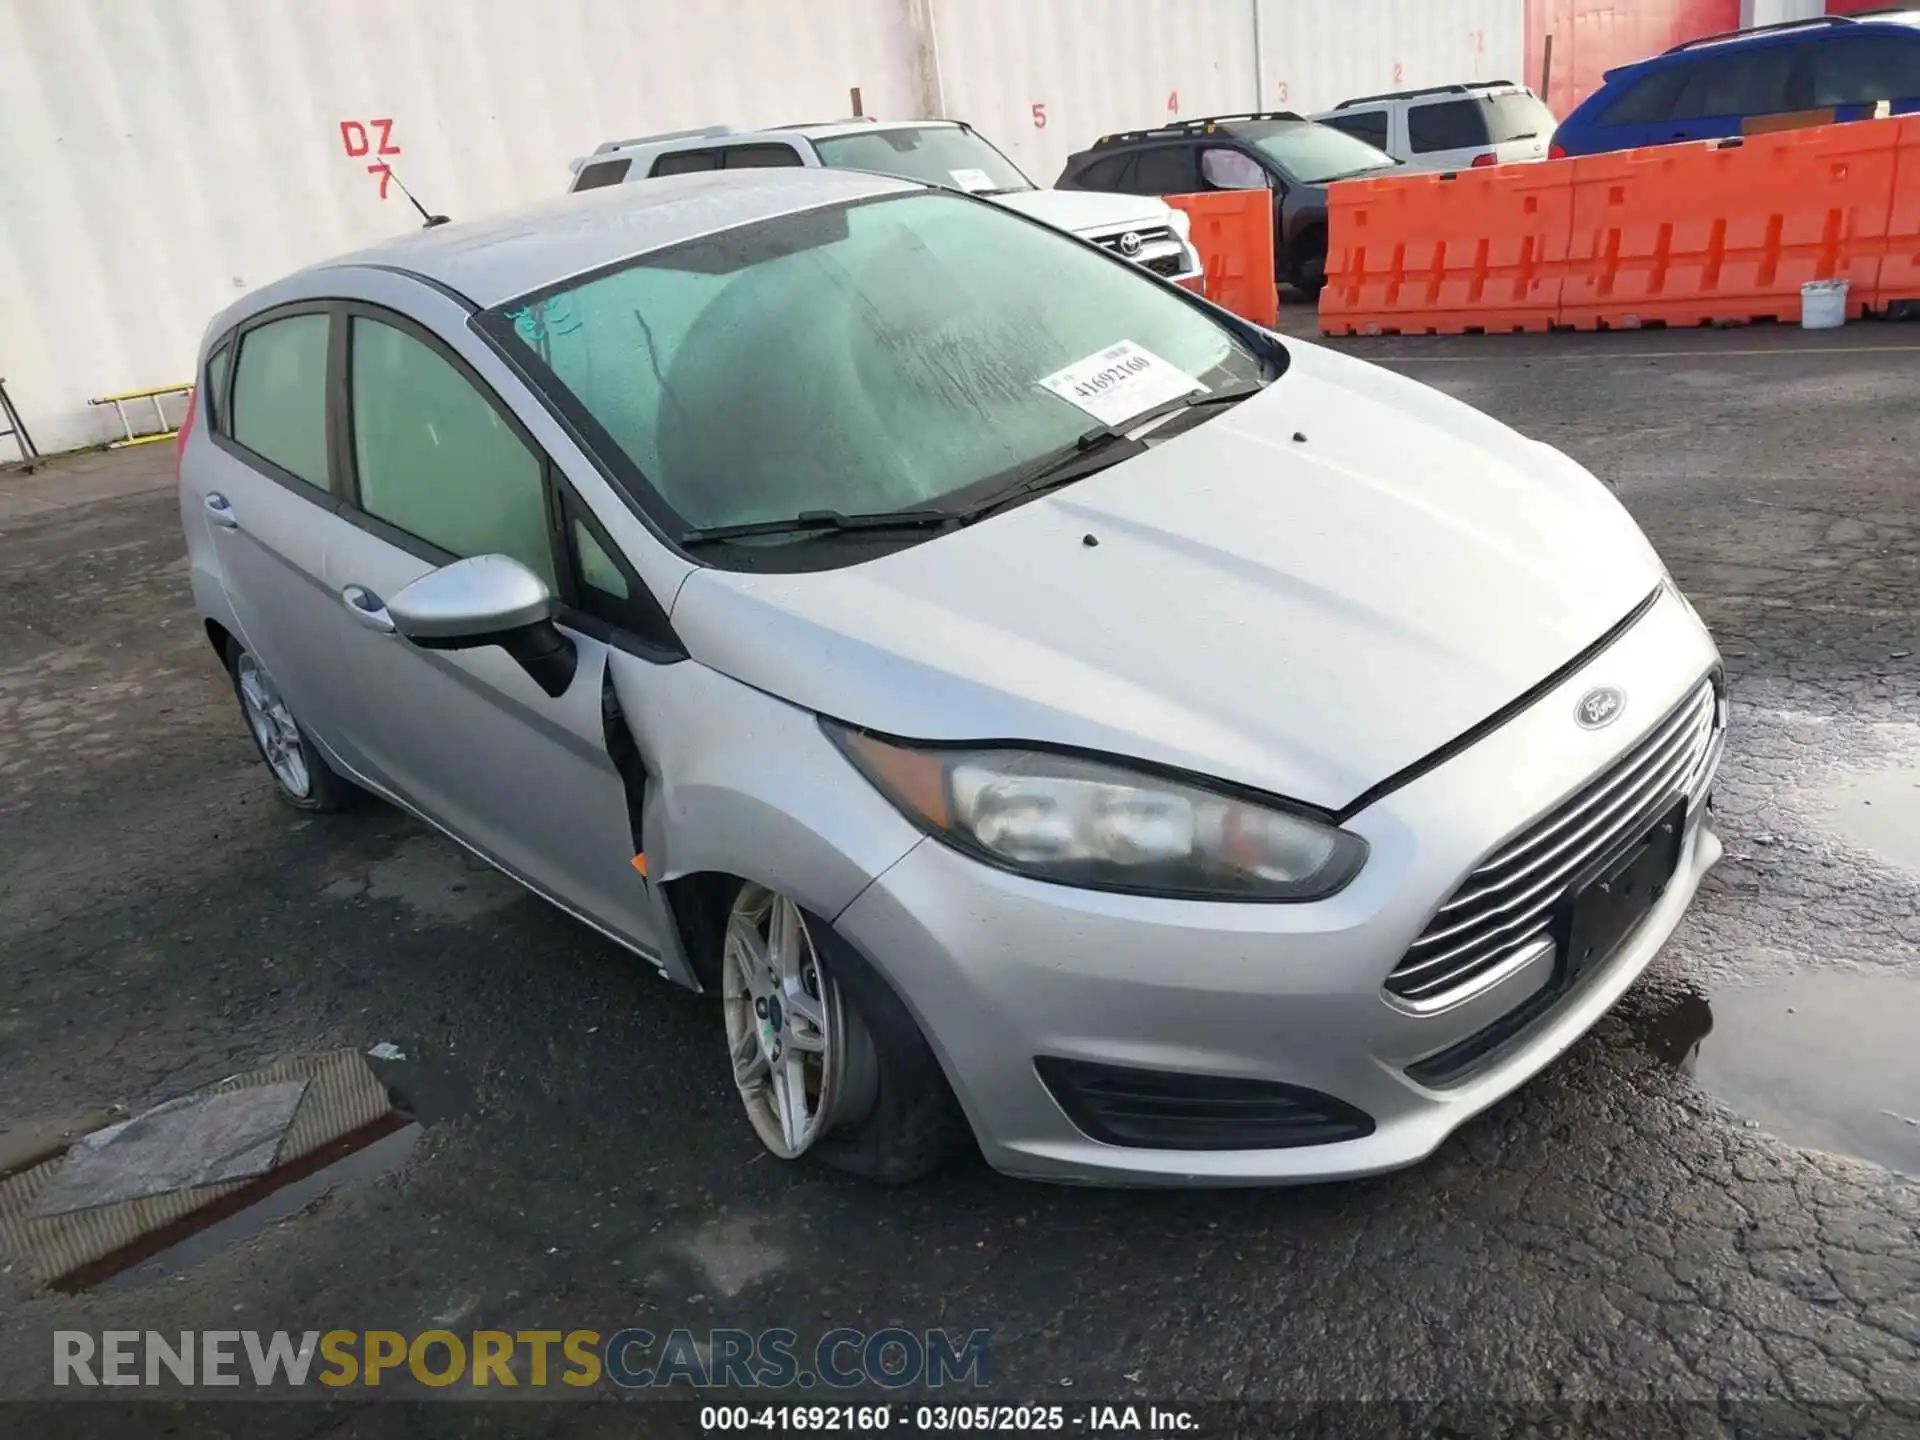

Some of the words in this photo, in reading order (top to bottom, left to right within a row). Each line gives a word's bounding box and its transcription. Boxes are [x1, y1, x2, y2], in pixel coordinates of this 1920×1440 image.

[1393, 63, 1404, 83] 2
[1167, 92, 1179, 115] 4
[1277, 82, 1288, 102] 3
[1032, 104, 1047, 128] 5
[367, 164, 392, 199] 7
[1074, 355, 1152, 397] 41692160
[1585, 693, 1616, 721] Ford
